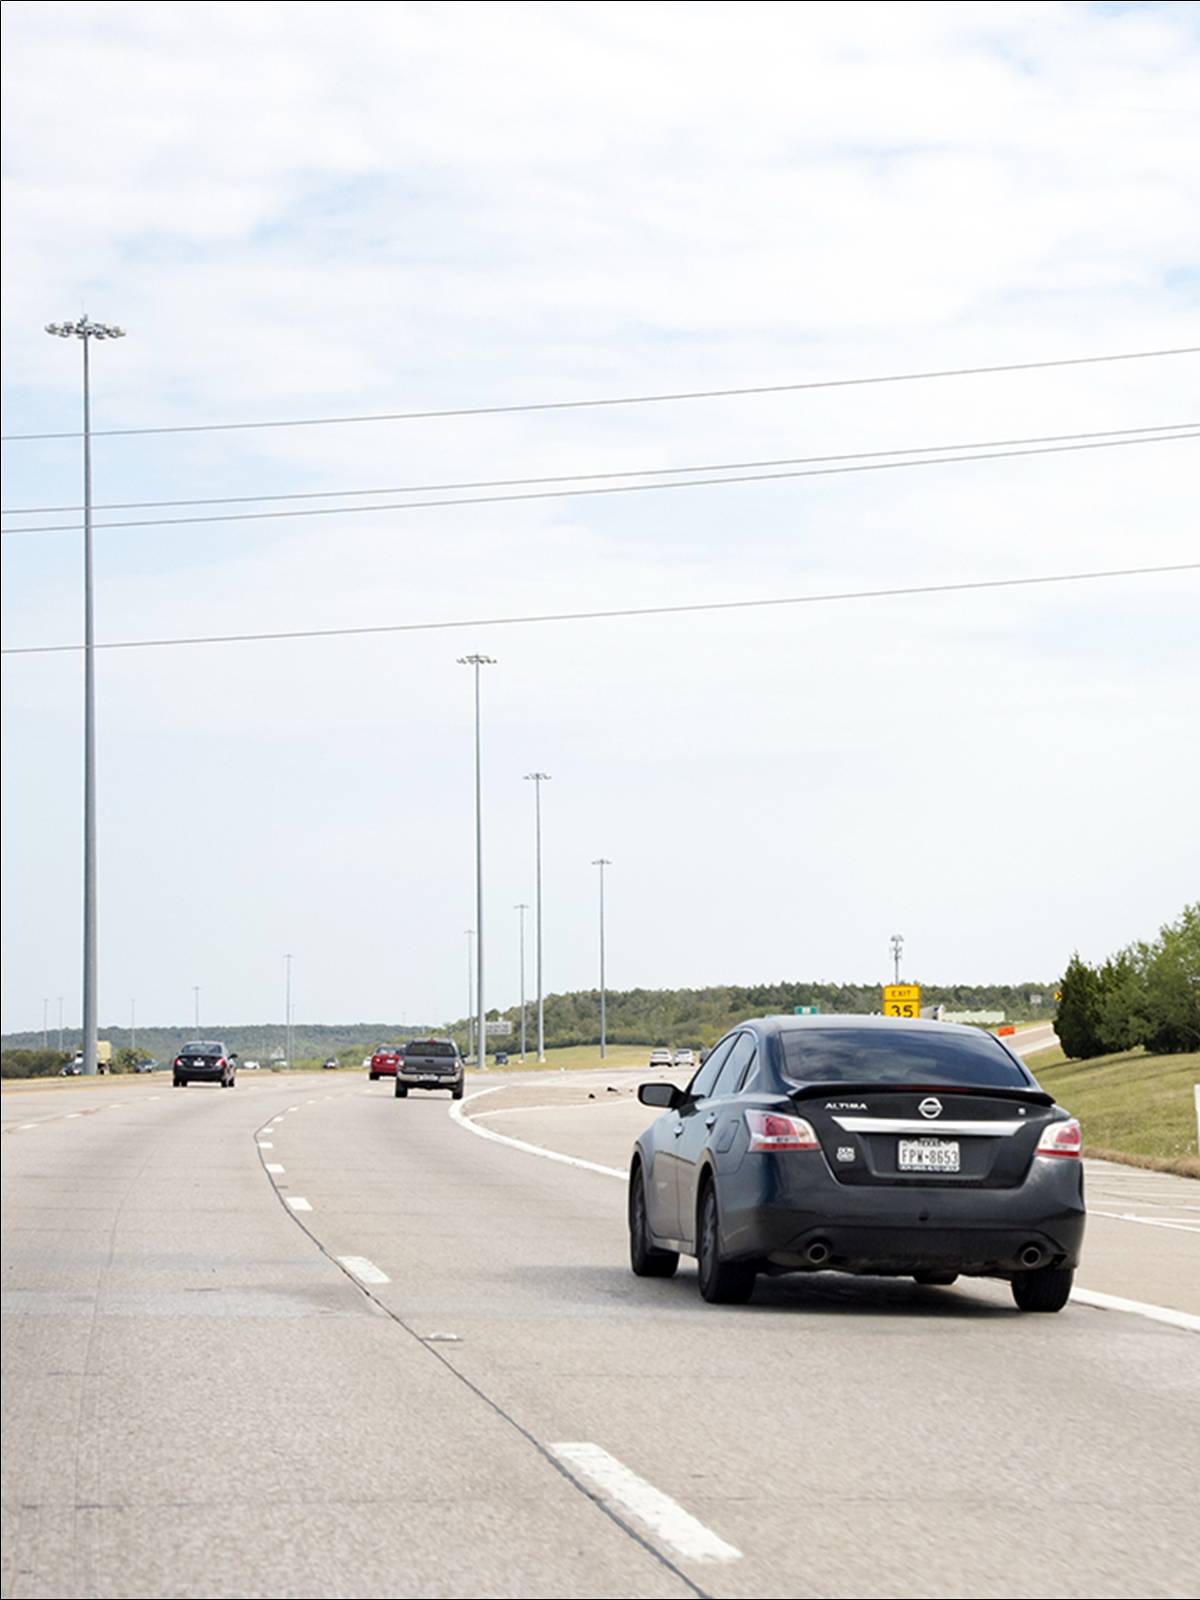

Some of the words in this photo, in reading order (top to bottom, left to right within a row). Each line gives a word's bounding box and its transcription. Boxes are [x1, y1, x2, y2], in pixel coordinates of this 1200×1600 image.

[891, 989, 911, 998] EXIT
[891, 1004, 914, 1018] 35
[824, 1102, 868, 1110] ALTIMA
